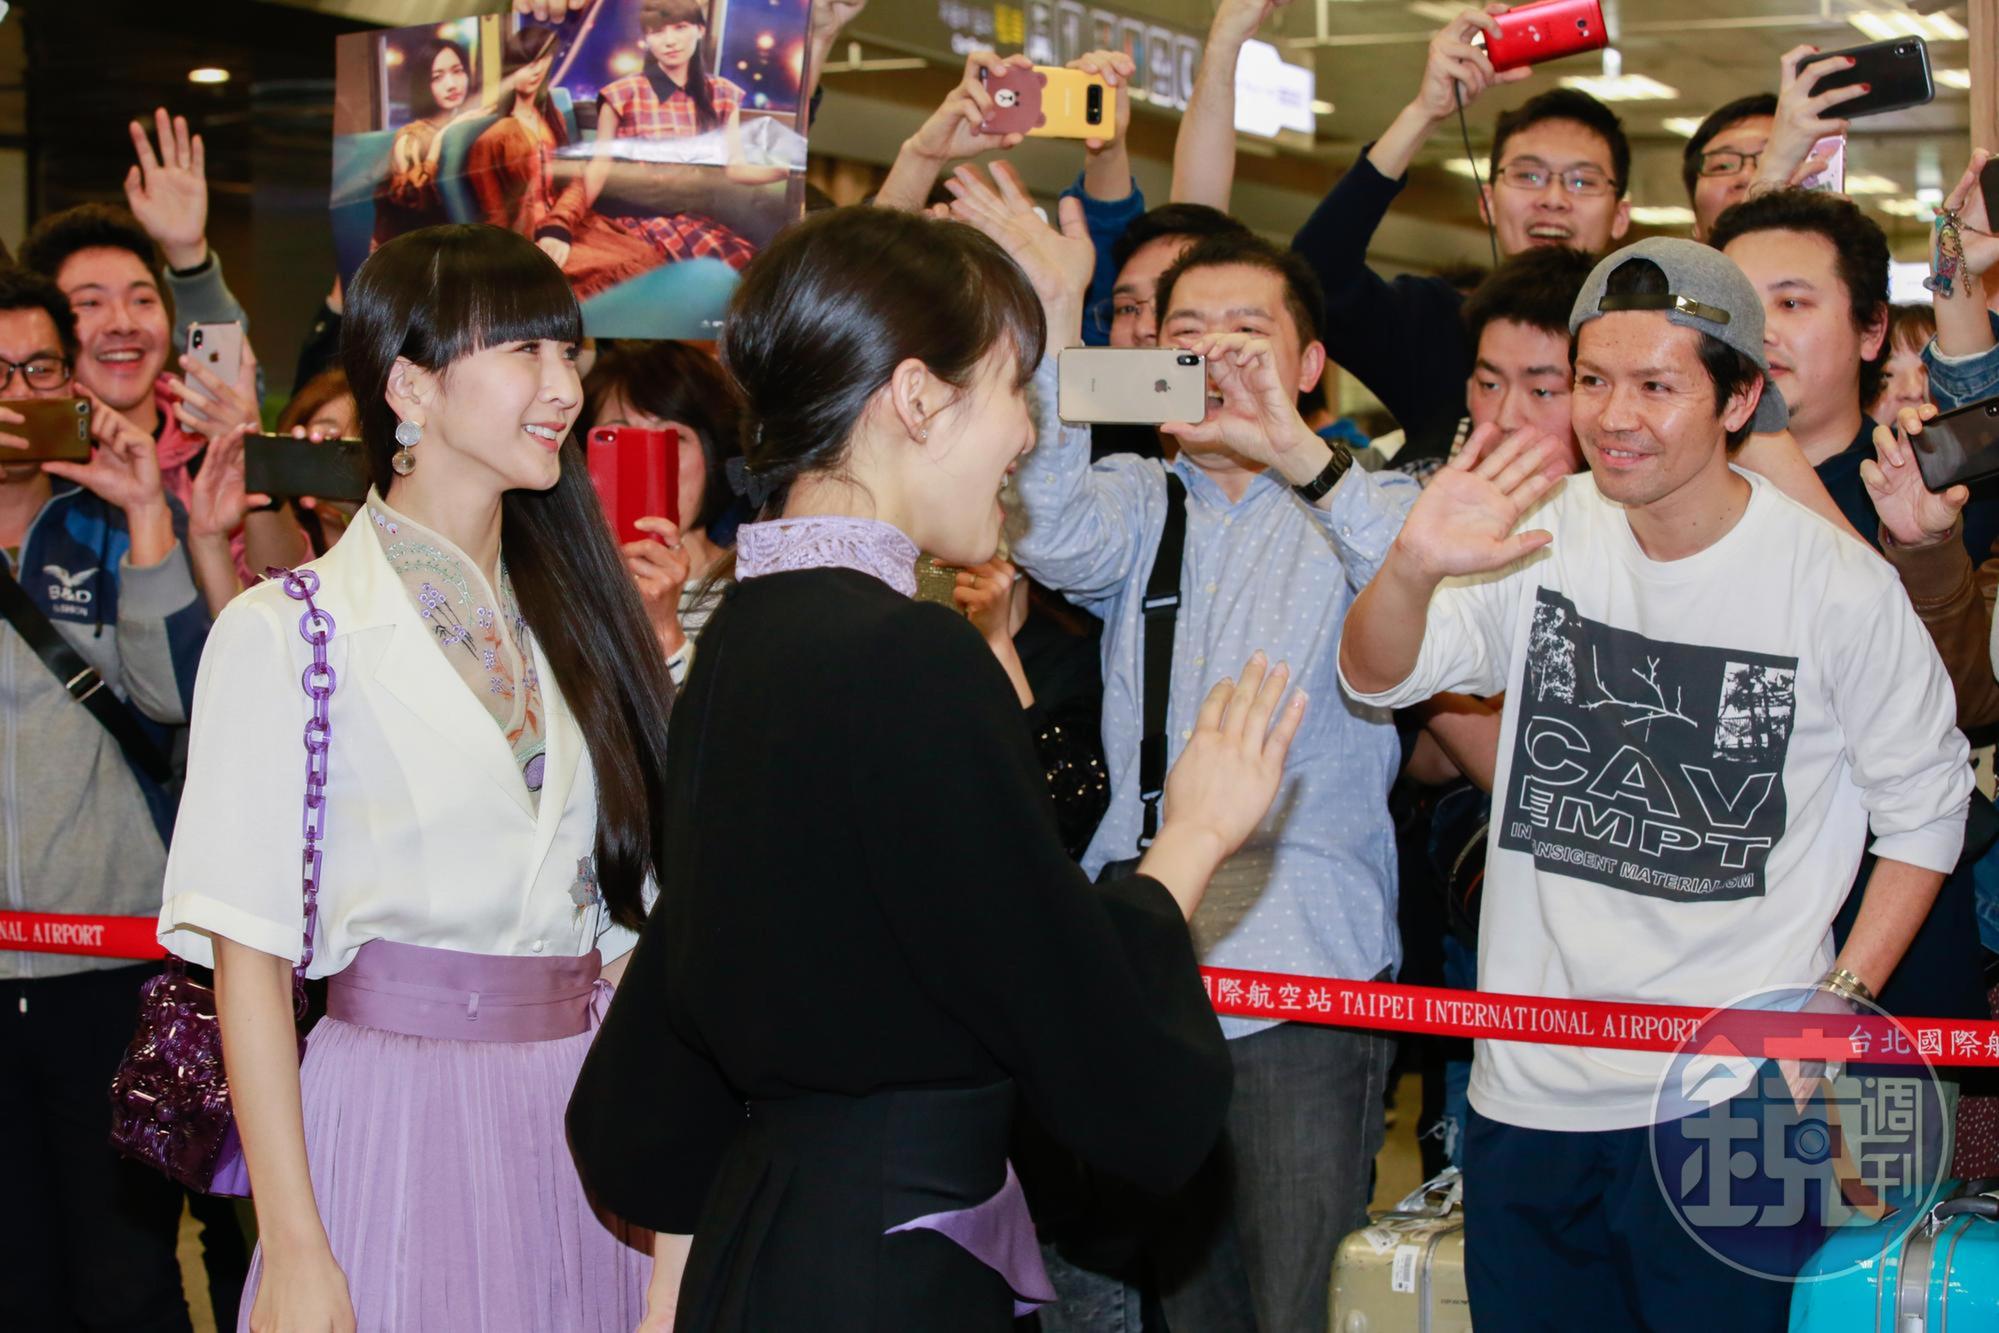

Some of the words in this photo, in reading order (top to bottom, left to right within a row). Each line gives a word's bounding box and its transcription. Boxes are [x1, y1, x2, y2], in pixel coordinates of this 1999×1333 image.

[1524, 715, 1778, 829] CAV
[1519, 774, 1772, 869] EMPT
[32, 922, 106, 947] AIRPORT
[1340, 990, 1415, 1020] TAIPEI
[1425, 997, 1595, 1036] INTERNATIONAL
[1603, 1013, 1702, 1043] AIRPORT
